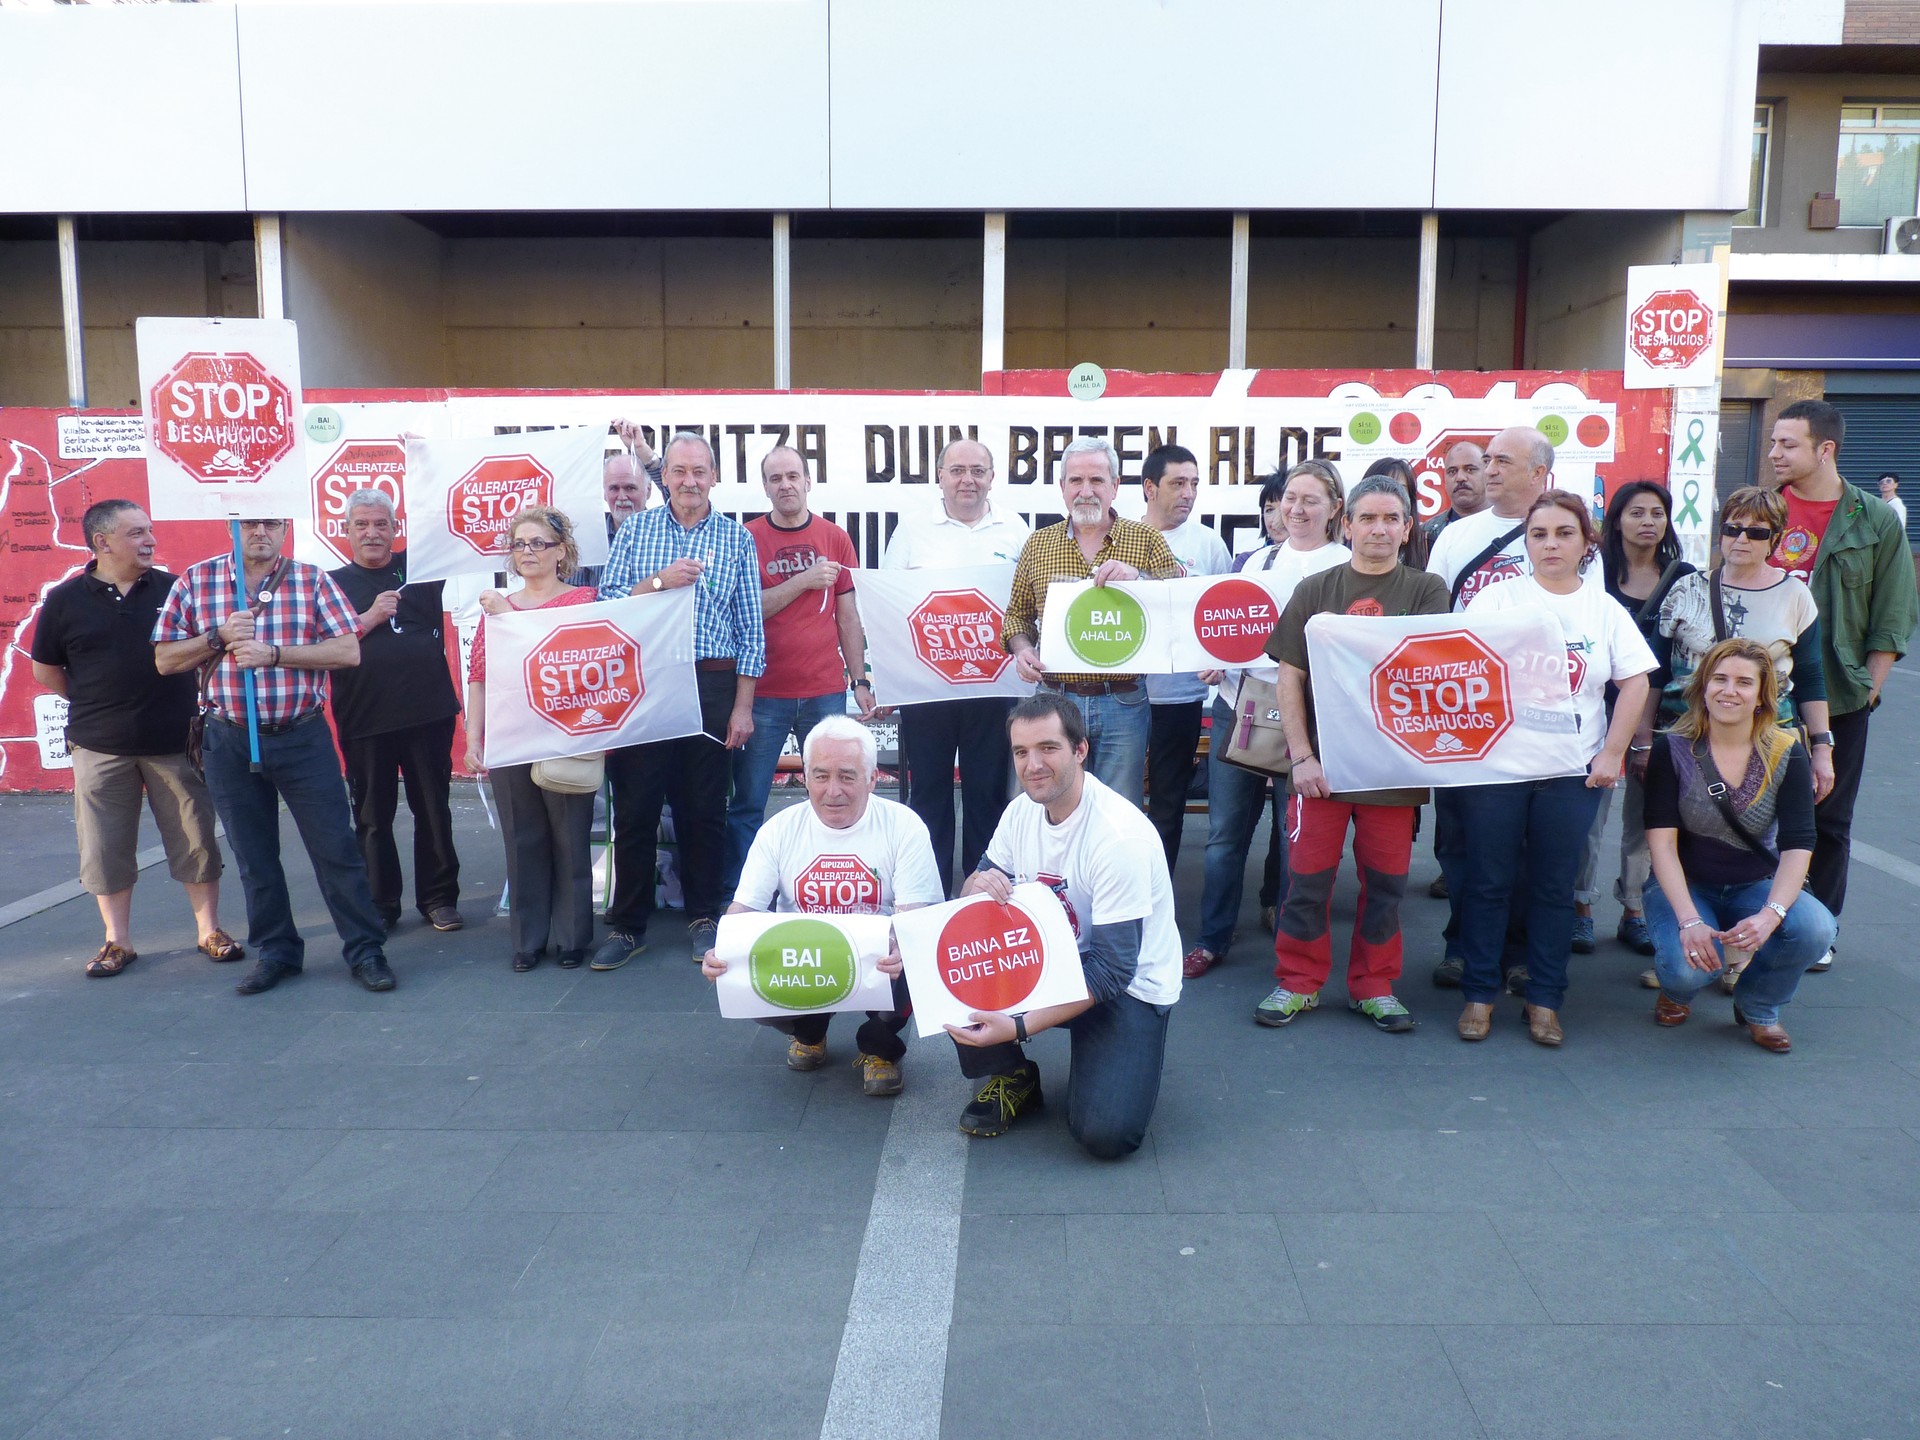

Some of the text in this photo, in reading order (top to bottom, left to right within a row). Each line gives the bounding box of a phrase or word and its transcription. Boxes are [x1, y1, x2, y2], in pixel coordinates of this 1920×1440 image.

[1640, 309, 1703, 332] STOP
[1639, 334, 1704, 347] DESAHUCIOS
[171, 380, 270, 420] STOP
[168, 420, 279, 445] DESAHUCIOS
[334, 462, 406, 473] KALERATZEA
[324, 474, 406, 515] STO
[463, 474, 544, 495] KALERATZEAK
[462, 488, 538, 524] STOP
[918, 610, 993, 626] KALERATZEAK
[1090, 610, 1121, 626] BAI
[1203, 604, 1270, 621] BAINA EZ
[922, 624, 995, 649] STOP
[1080, 631, 1132, 641] AHAL DA
[1201, 621, 1274, 638] DUTE NAHI
[538, 642, 627, 664] KALERATZEAK
[539, 658, 626, 696] STOP
[1386, 658, 1489, 682] KALERATZEAK
[543, 687, 631, 712] DESAHUCIOS
[1388, 677, 1490, 717] STOP
[1392, 712, 1495, 734] DESAHUCIOS
[820, 861, 855, 869] GIPUZKOA
[808, 872, 866, 881] KALERATZEAK
[803, 881, 873, 906] STOP
[948, 927, 1031, 962] BAINA EZ
[782, 948, 821, 968] BAI
[947, 948, 1039, 985] DUTE NAHI
[769, 974, 837, 987] AHAL DA
